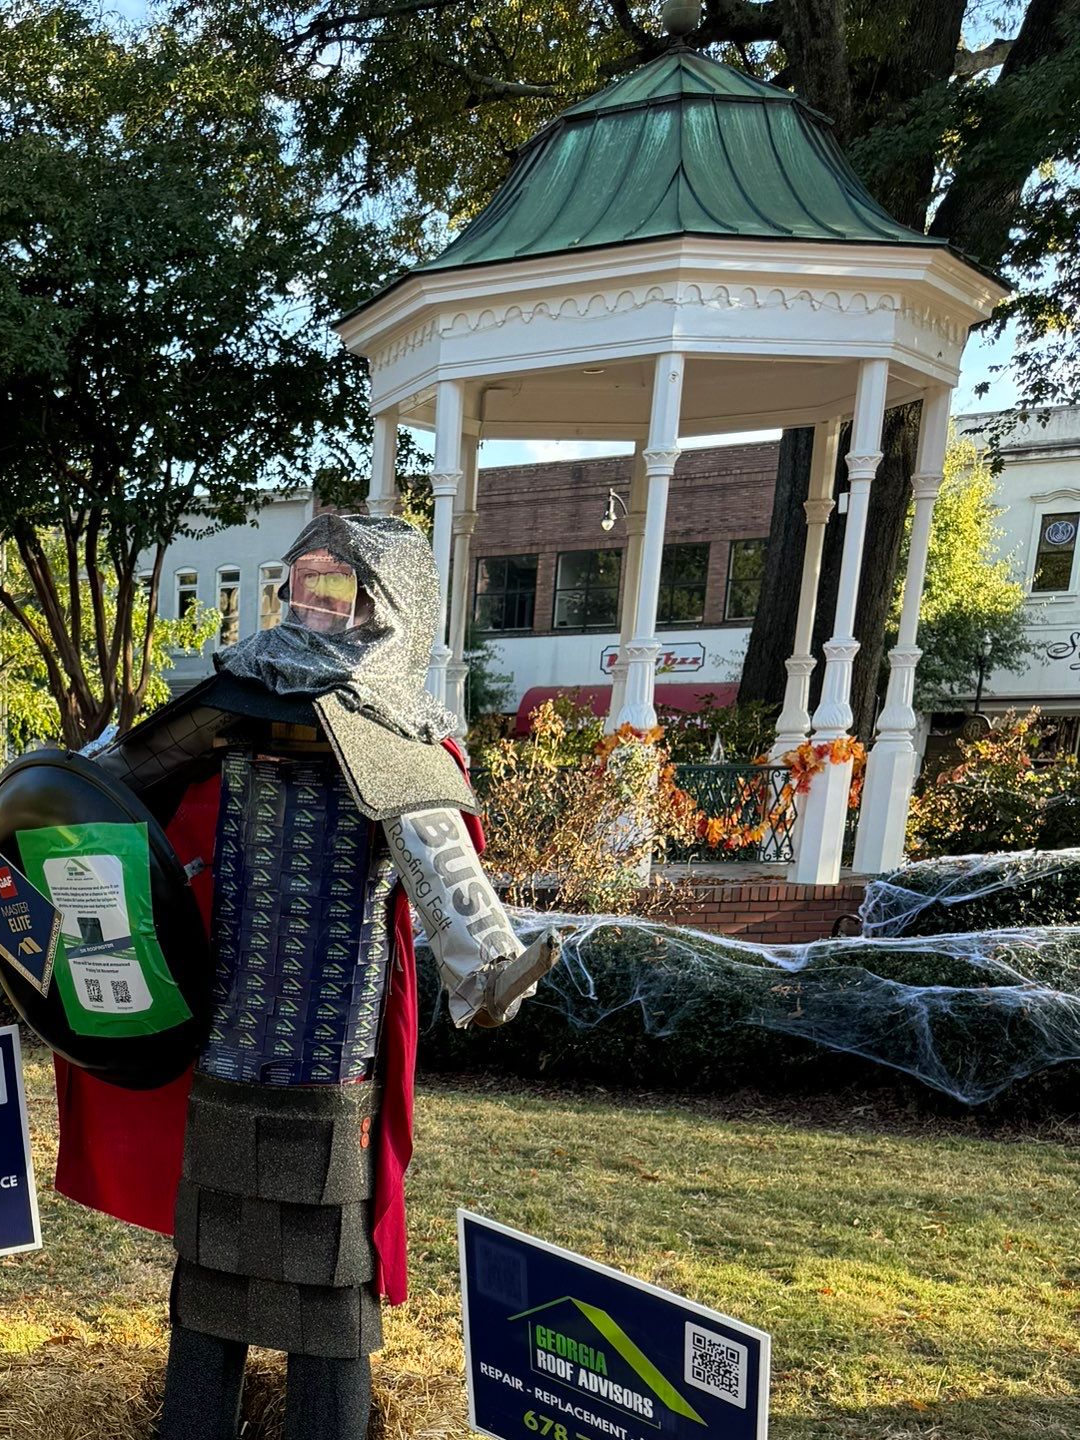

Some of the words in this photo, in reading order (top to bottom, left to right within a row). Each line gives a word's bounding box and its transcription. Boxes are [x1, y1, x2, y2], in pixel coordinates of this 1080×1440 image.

[388, 822, 433, 899] Roofing
[426, 895, 452, 931] Felt
[0, 901, 29, 918] MASTER
[8, 914, 33, 933] ELITE
[47, 917, 61, 963] CONTRACTOR
[536, 1324, 608, 1377] GEORGIA
[480, 1361, 524, 1393] REPAIR
[534, 1387, 628, 1440] REPLACEMENT
[536, 1348, 574, 1382] ROOF
[577, 1371, 654, 1419] ADVISORS
